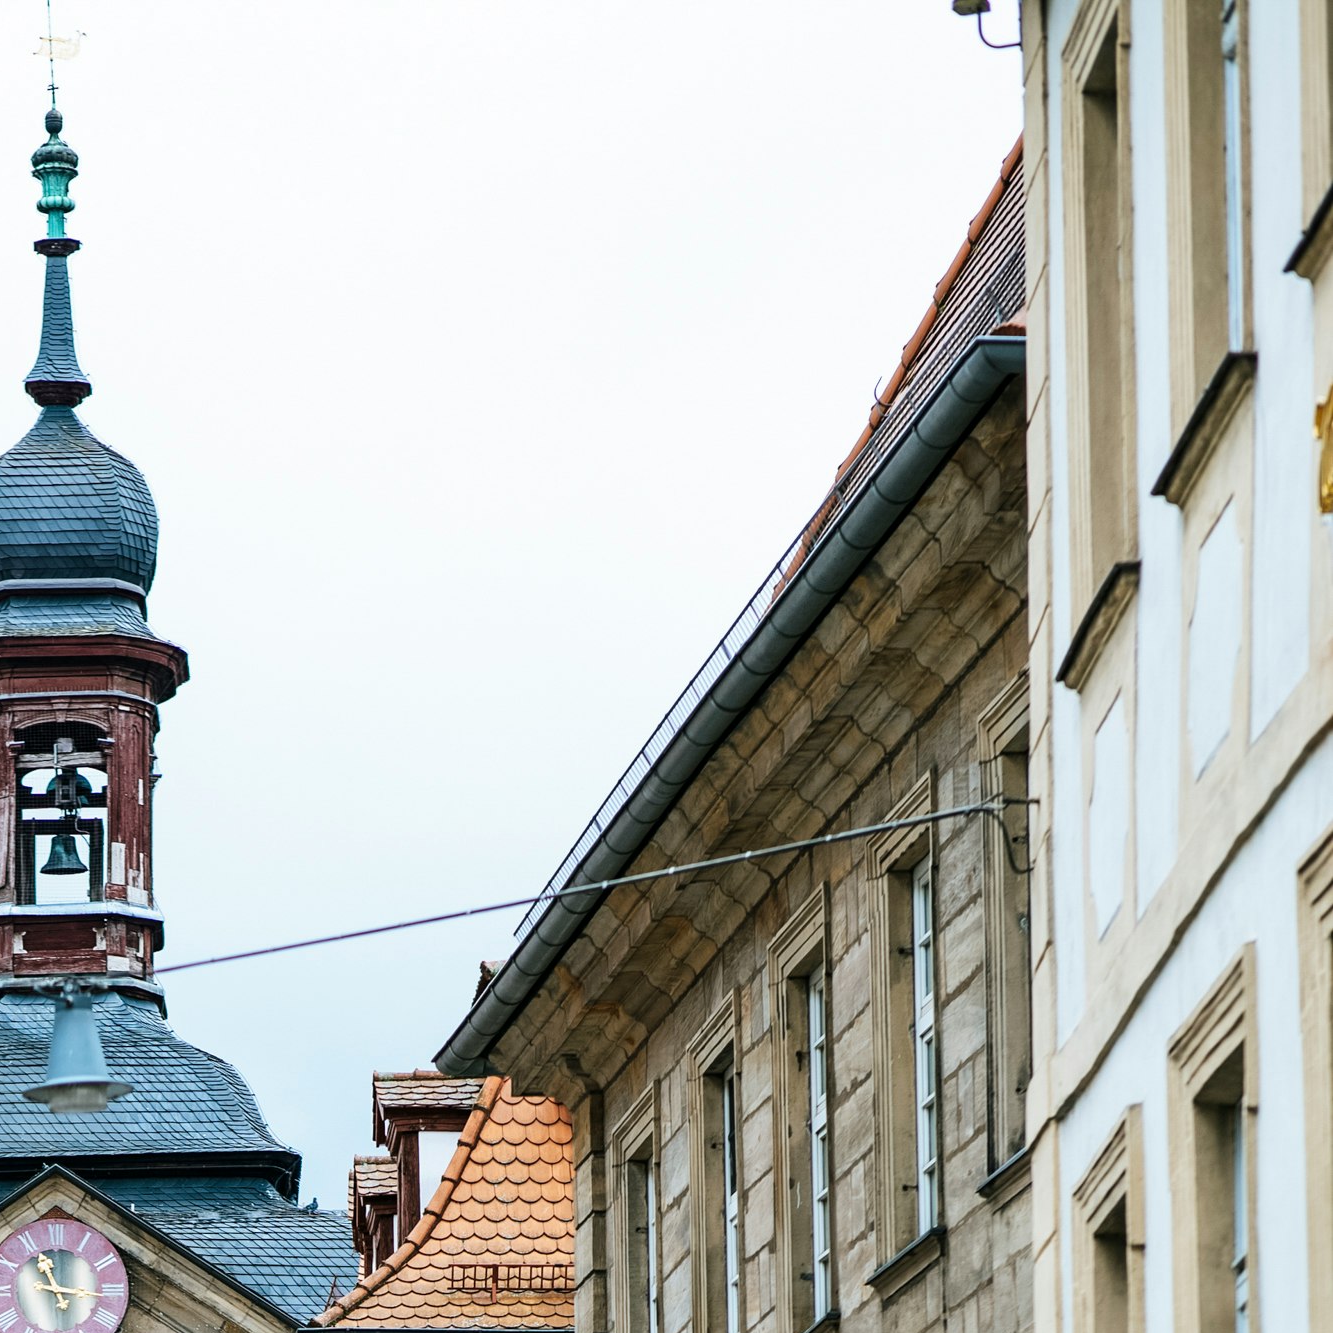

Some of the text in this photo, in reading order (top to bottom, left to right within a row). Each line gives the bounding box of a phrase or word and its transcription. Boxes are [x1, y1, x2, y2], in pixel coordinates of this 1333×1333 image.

[17, 1231, 38, 1255] XI
[47, 1224, 64, 1246] XII
[77, 1232, 92, 1252] I
[93, 1252, 117, 1272] II
[93, 1307, 119, 1330] IIII
